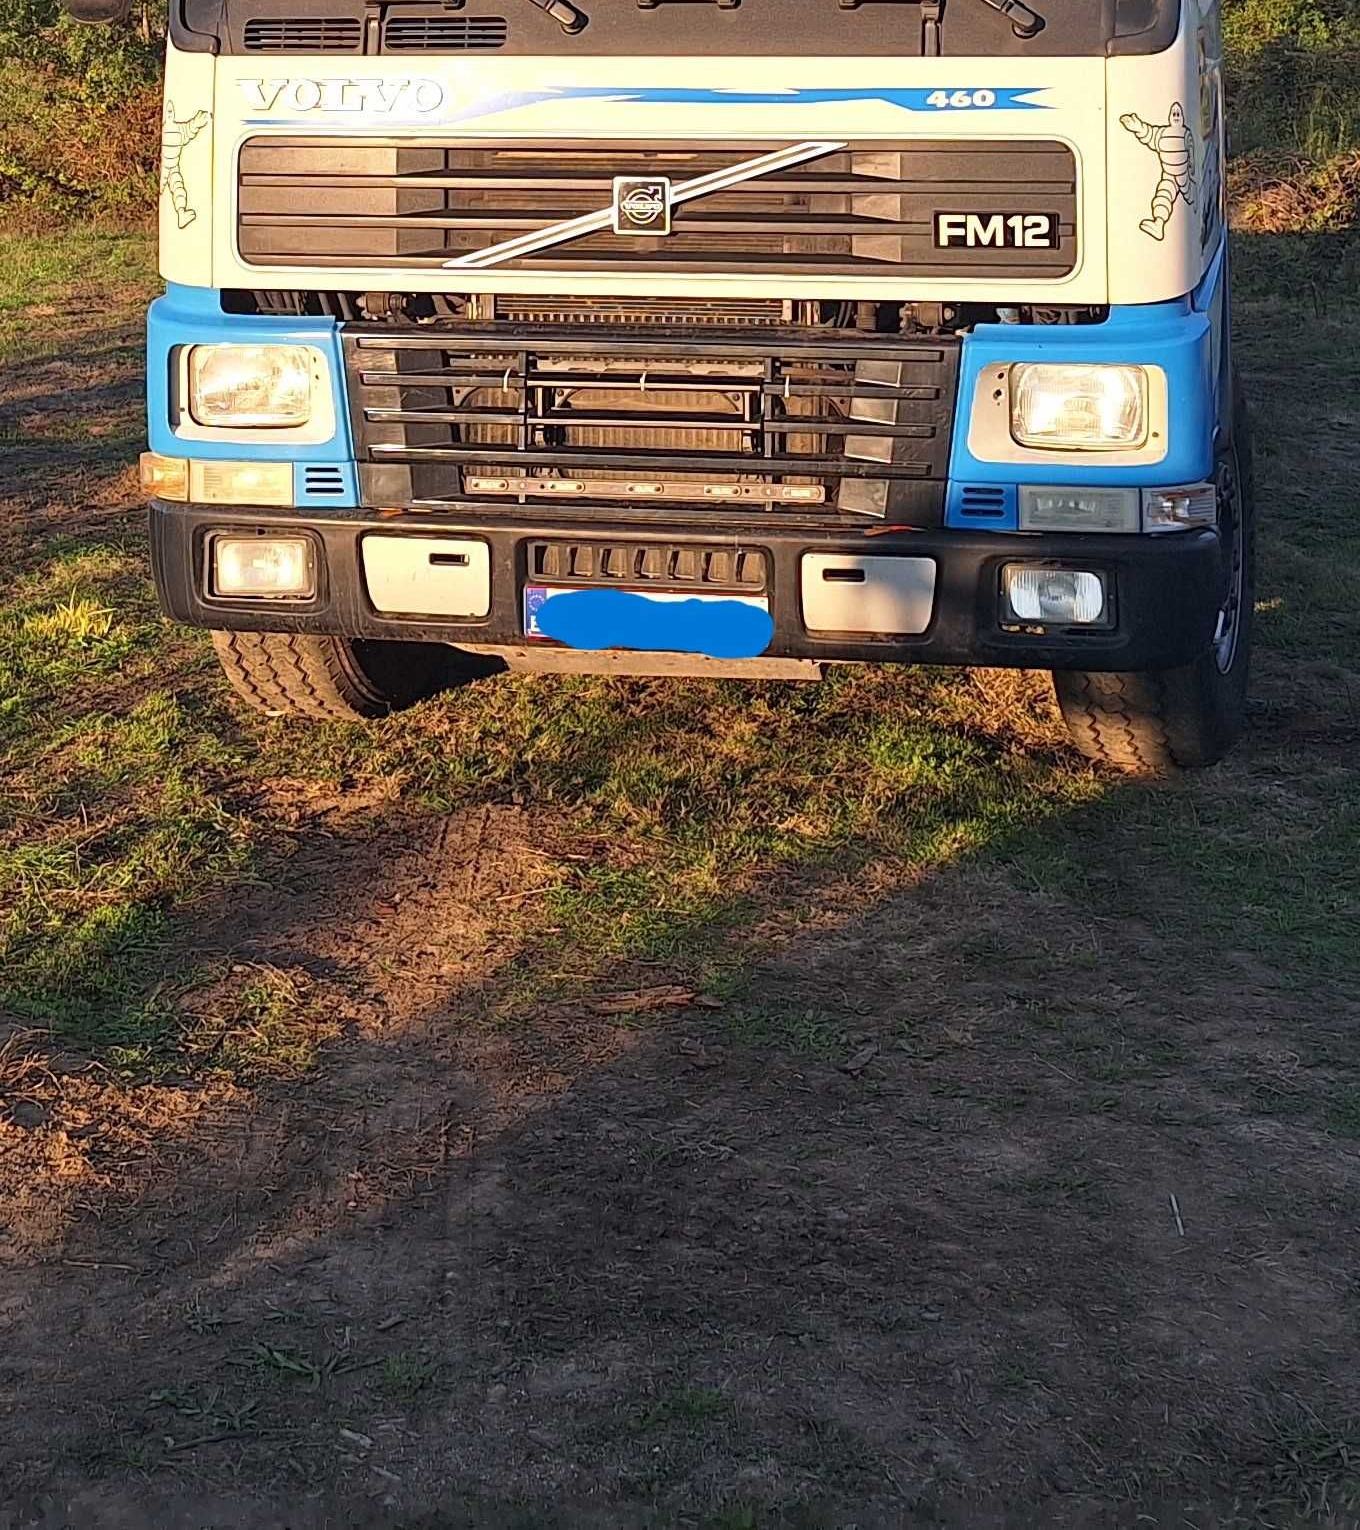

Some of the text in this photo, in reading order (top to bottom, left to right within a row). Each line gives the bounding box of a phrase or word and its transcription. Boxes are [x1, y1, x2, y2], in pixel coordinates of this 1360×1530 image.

[233, 78, 443, 112] VOLVO
[925, 90, 996, 108] 460
[938, 214, 1051, 247] FM12
